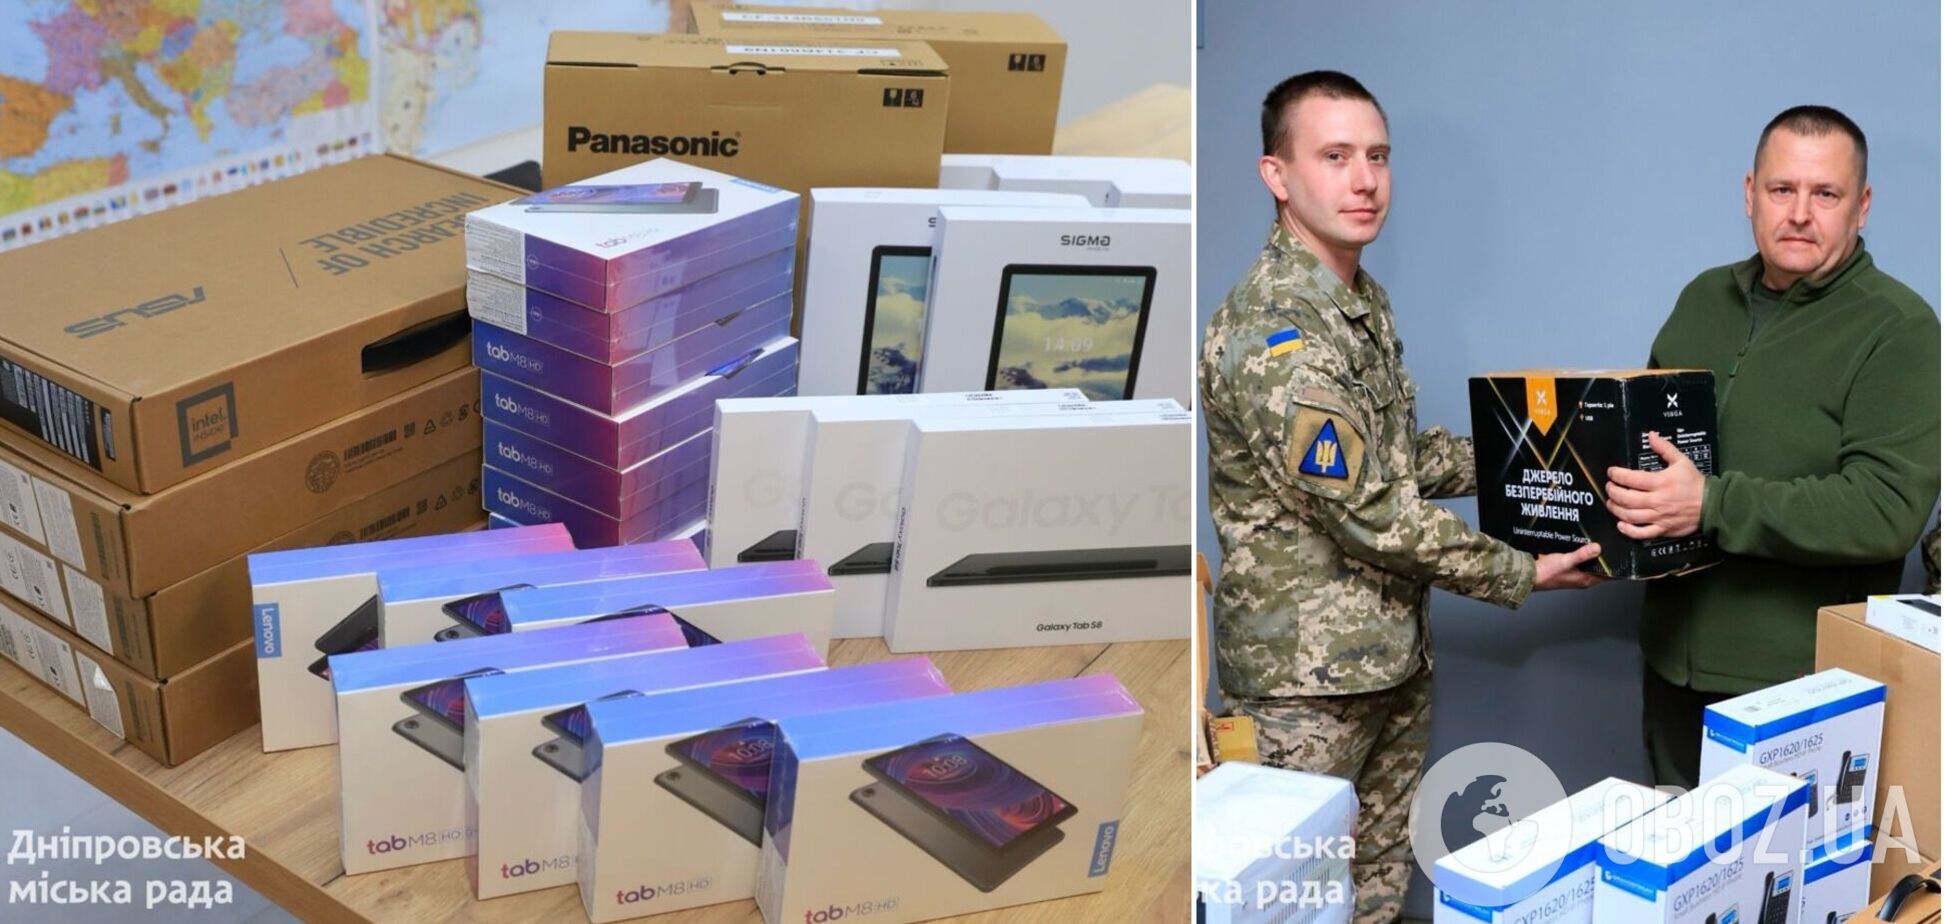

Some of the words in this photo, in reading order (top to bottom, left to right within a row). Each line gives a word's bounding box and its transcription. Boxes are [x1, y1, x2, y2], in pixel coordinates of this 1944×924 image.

[568, 126, 738, 157] Panasonic
[298, 191, 490, 253] INCREDIBLE
[1060, 234, 1111, 247] SIGMA
[317, 253, 371, 276] OF
[64, 285, 206, 339] ASUS
[1522, 468, 1573, 486] ДЖЕРЕЛО
[1505, 484, 1594, 506] БЕЗПЕРЕБІЙНОГО
[1521, 503, 1580, 522] ЖИВЛЕННЯ
[1555, 531, 1571, 541] Power
[262, 608, 274, 654] Lenovo
[1036, 623, 1072, 632] Galaxy
[1072, 621, 1089, 630] Tab
[1090, 620, 1103, 629] S8
[1759, 732, 1824, 765] GXP1620/1625
[1092, 826, 1114, 873] Lenovo
[1674, 856, 1744, 911] GXP1620/1625
